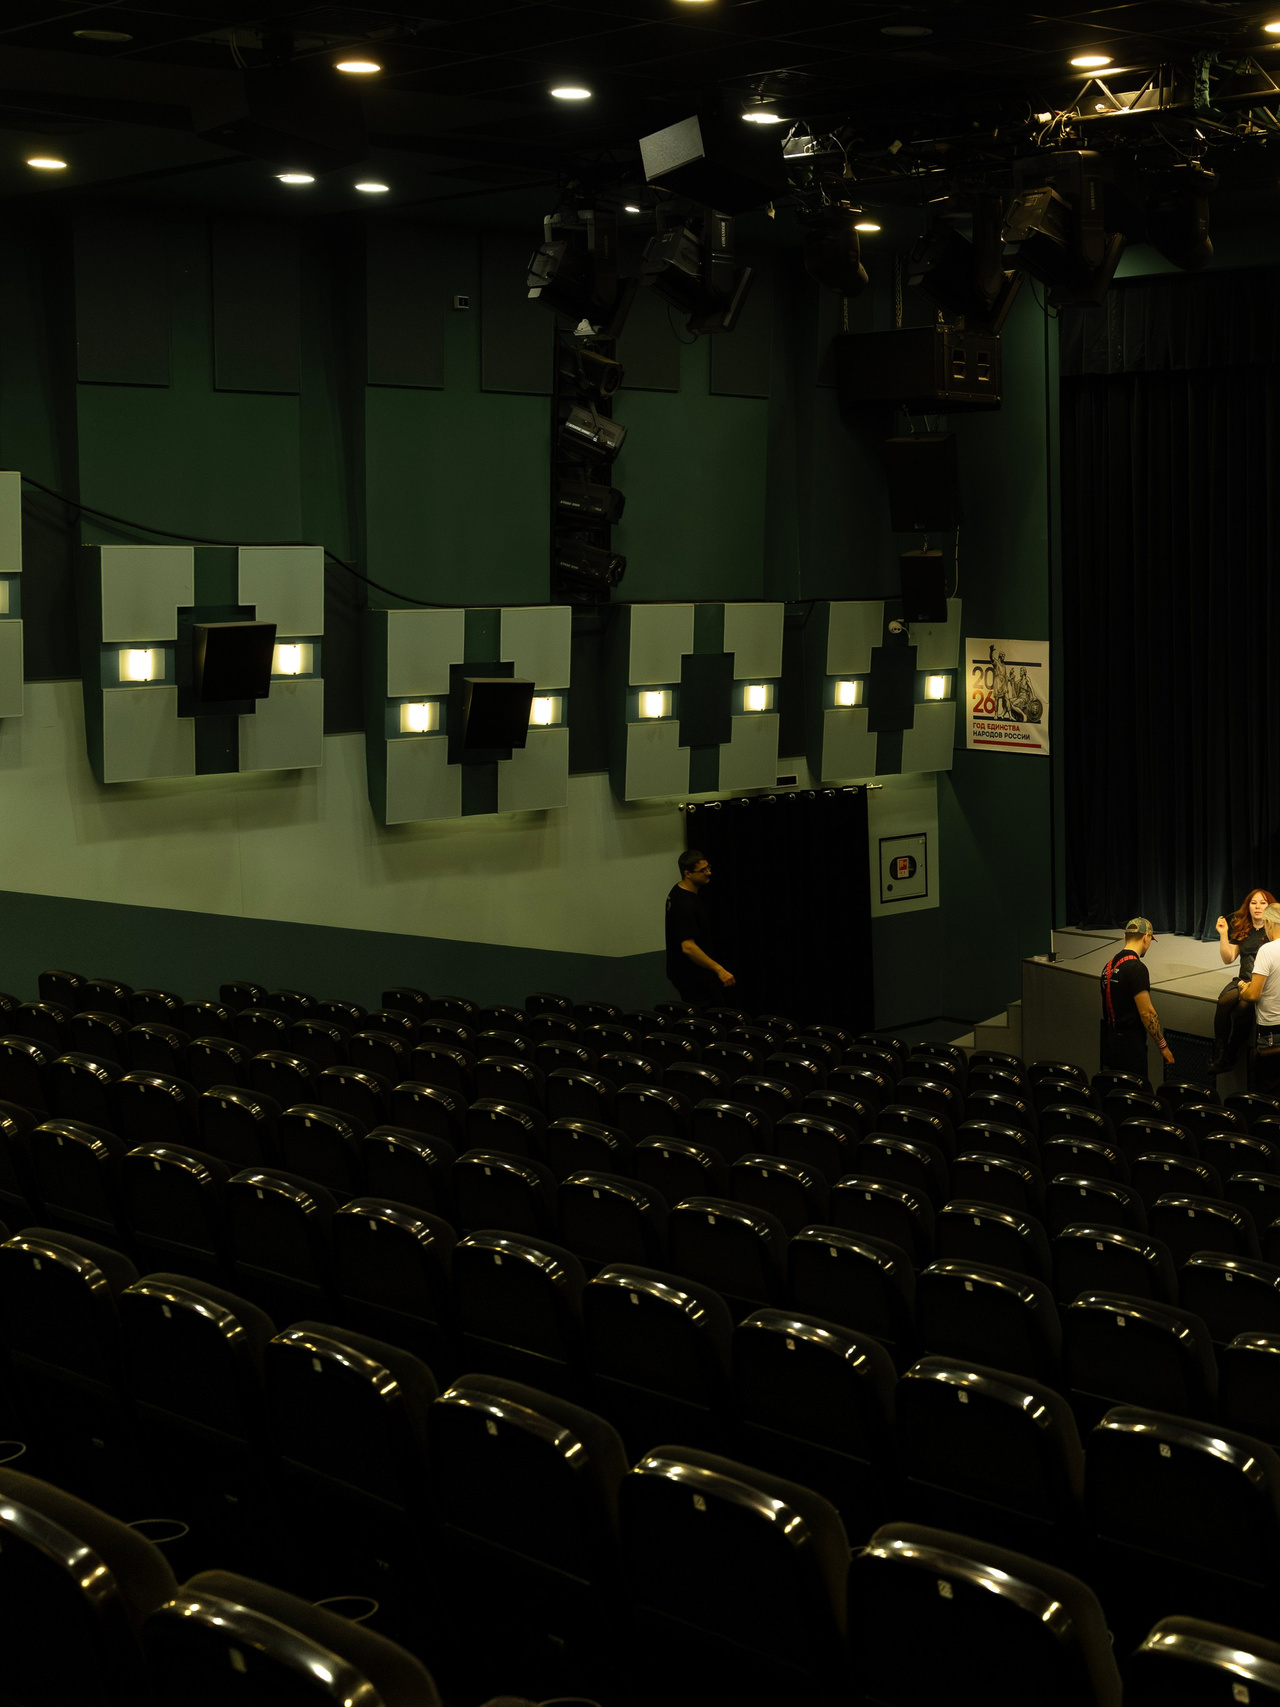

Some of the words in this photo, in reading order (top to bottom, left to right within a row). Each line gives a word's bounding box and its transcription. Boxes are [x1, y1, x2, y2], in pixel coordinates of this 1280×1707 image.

[972, 666, 995, 690] 20
[972, 690, 995, 714] 26
[973, 722, 985, 730] ГОД
[987, 723, 1021, 732] ЕДИНСТВА
[973, 730, 1003, 739] НАРОДОВ
[1004, 732, 1031, 741] РОССИИ
